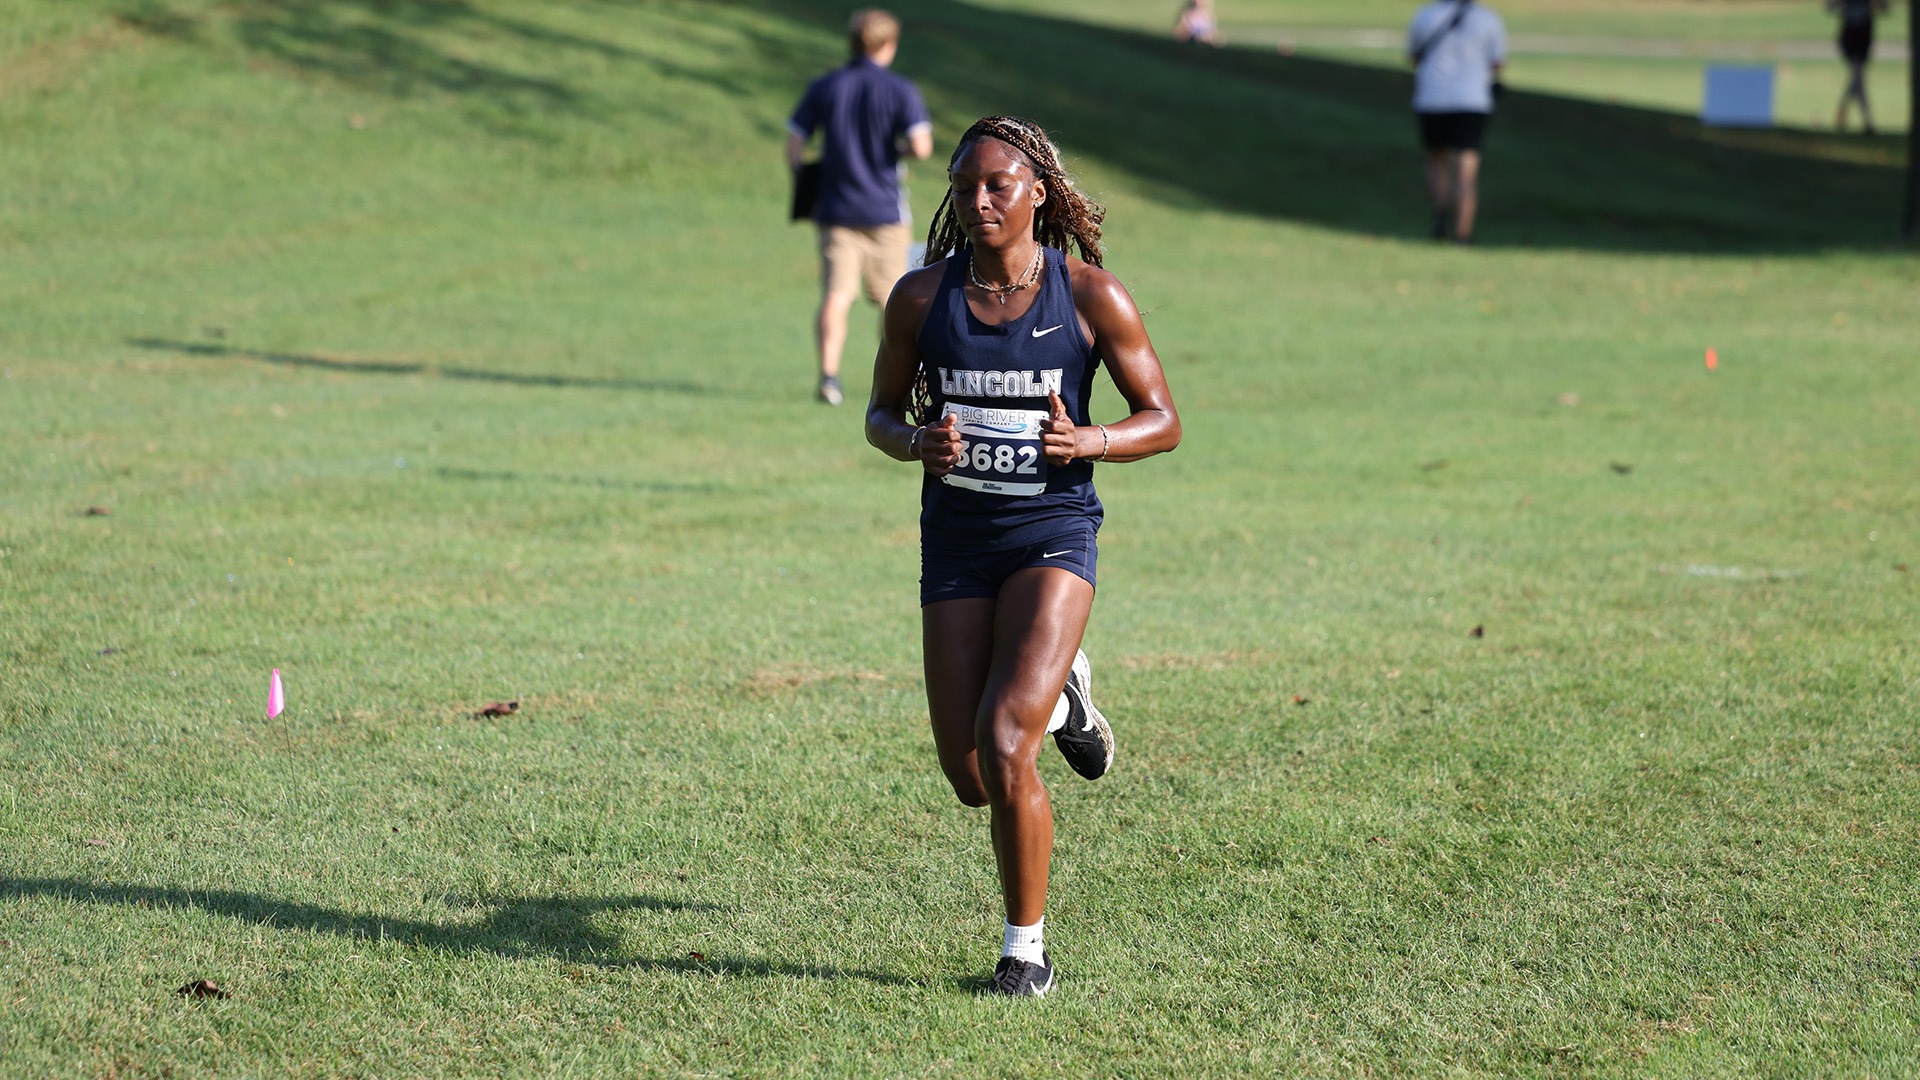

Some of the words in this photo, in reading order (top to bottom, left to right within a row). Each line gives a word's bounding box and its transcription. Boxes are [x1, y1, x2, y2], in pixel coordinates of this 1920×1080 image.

[938, 367, 1063, 397] LINCOLN
[961, 406, 983, 420] BIG
[986, 409, 1026, 423] RIVER
[955, 440, 1038, 474] 3682
